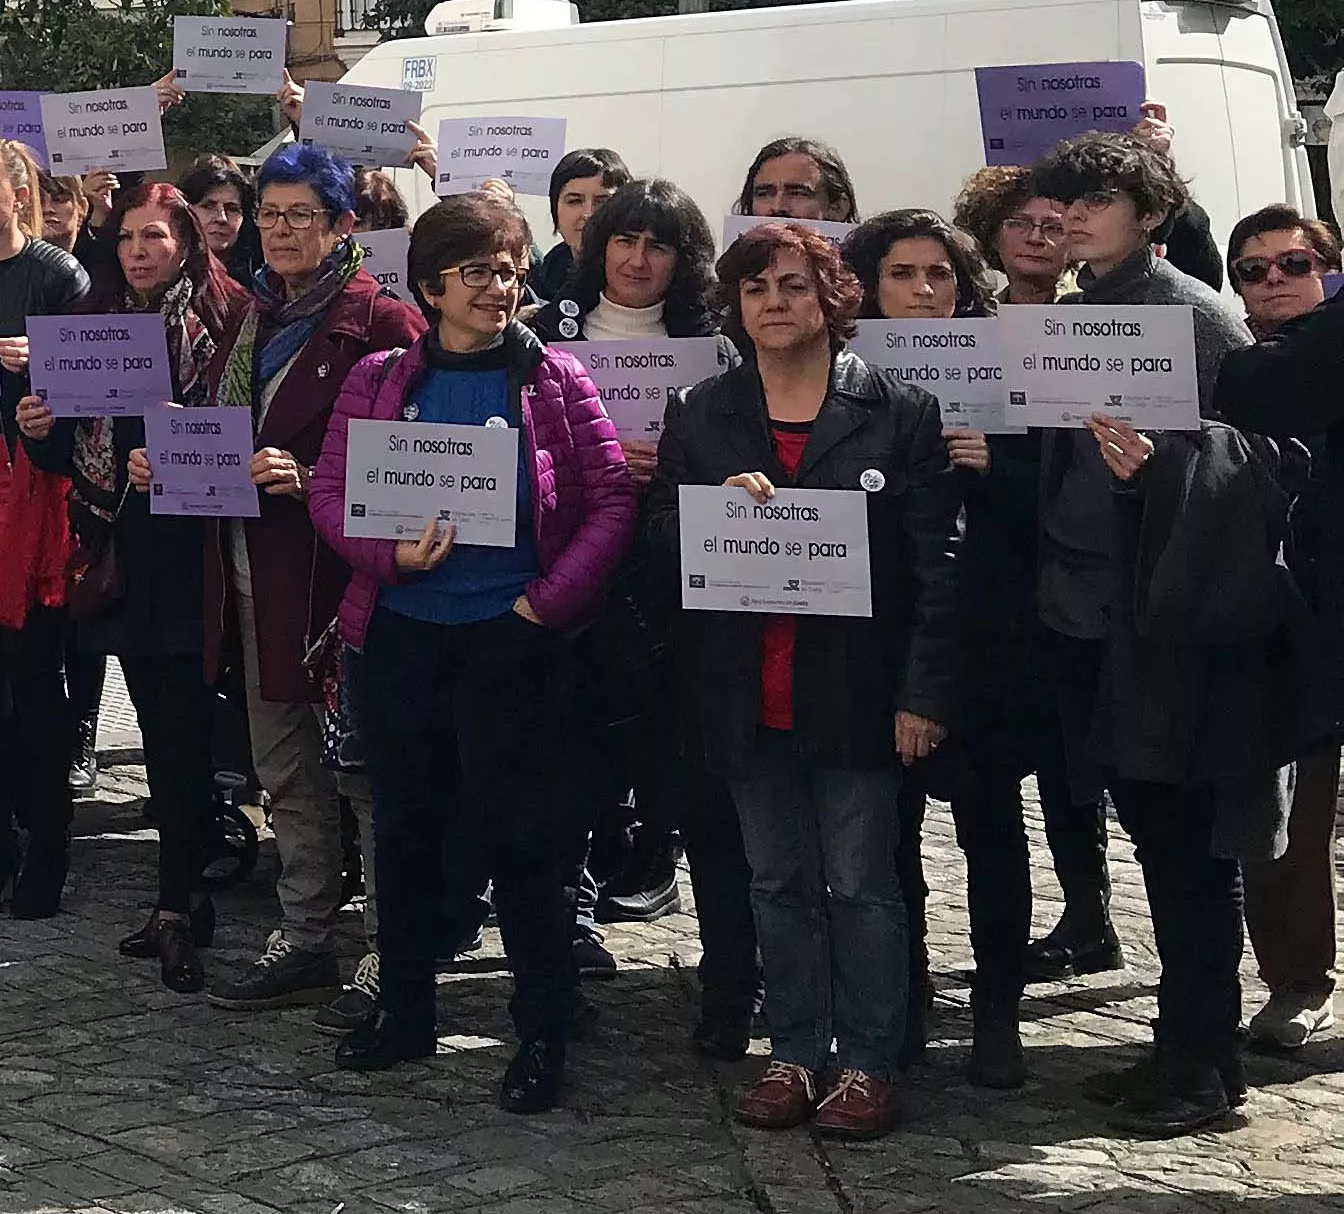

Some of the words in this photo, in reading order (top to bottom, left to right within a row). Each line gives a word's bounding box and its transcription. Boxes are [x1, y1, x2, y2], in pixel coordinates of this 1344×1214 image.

[200, 24, 215, 37] Sin
[185, 45, 196, 58] el
[197, 46, 233, 59] mundo
[234, 49, 246, 60] se
[248, 49, 273, 61] para
[404, 58, 433, 78] FRBX
[1016, 76, 1037, 93] Sin
[331, 91, 347, 105] Sin
[68, 101, 83, 115] Sin
[1016, 104, 1069, 121] mundo
[1092, 105, 1128, 122] para
[56, 126, 67, 139] el
[68, 123, 105, 138] mundo
[107, 124, 119, 135] se
[121, 121, 148, 136] para
[326, 116, 365, 130] mundo
[380, 120, 406, 135] para
[467, 125, 484, 137] Sin
[463, 144, 503, 158] mundo
[521, 147, 550, 160] para
[59, 327, 77, 344] Sin
[1043, 317, 1067, 336] Sin
[1072, 318, 1145, 339] nosotras,
[885, 332, 907, 348] Sin
[43, 356, 56, 372] el
[58, 355, 102, 371] mundo
[104, 357, 120, 371] se
[122, 357, 153, 373] para
[589, 353, 610, 370] Sin
[615, 351, 678, 369] nosotras,
[1022, 353, 1037, 371] el
[1042, 353, 1101, 372] mundo
[1105, 357, 1125, 373] se
[1130, 357, 1173, 376] para
[944, 367, 961, 381] se
[644, 386, 661, 401] se
[169, 418, 184, 435] Sin
[388, 434, 409, 452] Sin
[170, 449, 203, 466] mundo
[216, 453, 241, 469] para
[366, 467, 380, 484] el
[383, 469, 435, 487] mundo
[438, 474, 456, 489] se
[460, 475, 497, 493] para
[725, 500, 748, 519] Sin
[753, 502, 822, 523] nosotras,
[703, 535, 718, 553] el
[723, 536, 780, 556] mundo
[784, 541, 803, 557] se
[808, 542, 847, 561] para
